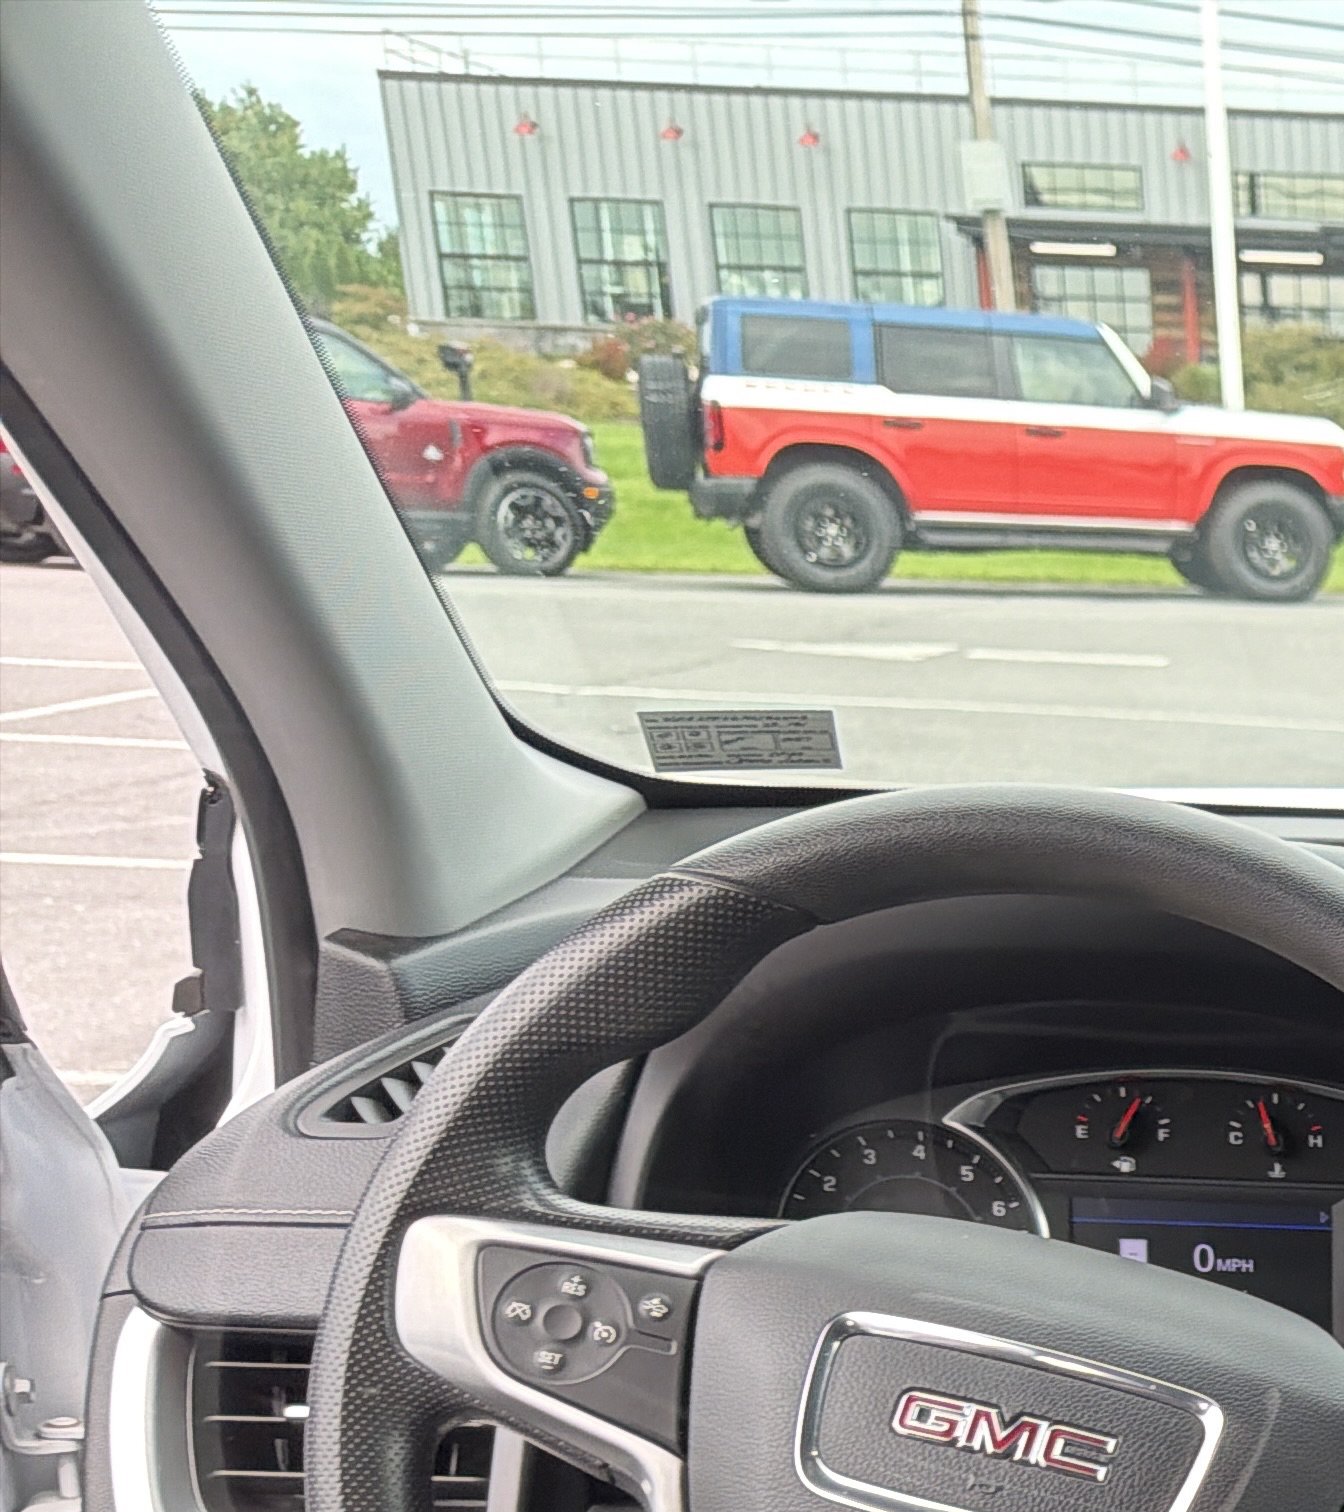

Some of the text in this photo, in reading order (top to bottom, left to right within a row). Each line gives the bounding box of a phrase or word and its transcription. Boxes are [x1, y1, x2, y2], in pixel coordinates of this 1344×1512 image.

[1075, 1125, 1089, 1139] E
[1157, 1128, 1171, 1142] F
[1229, 1131, 1243, 1145] C
[1308, 1134, 1323, 1148] H
[863, 1149, 877, 1165] 3
[912, 1145, 926, 1160] 4
[960, 1165, 974, 1182] 5
[823, 1176, 837, 1192] 2
[992, 1200, 1006, 1217] 6
[1193, 1243, 1255, 1273] 0 MPH
[891, 1391, 1118, 1482] GMC
